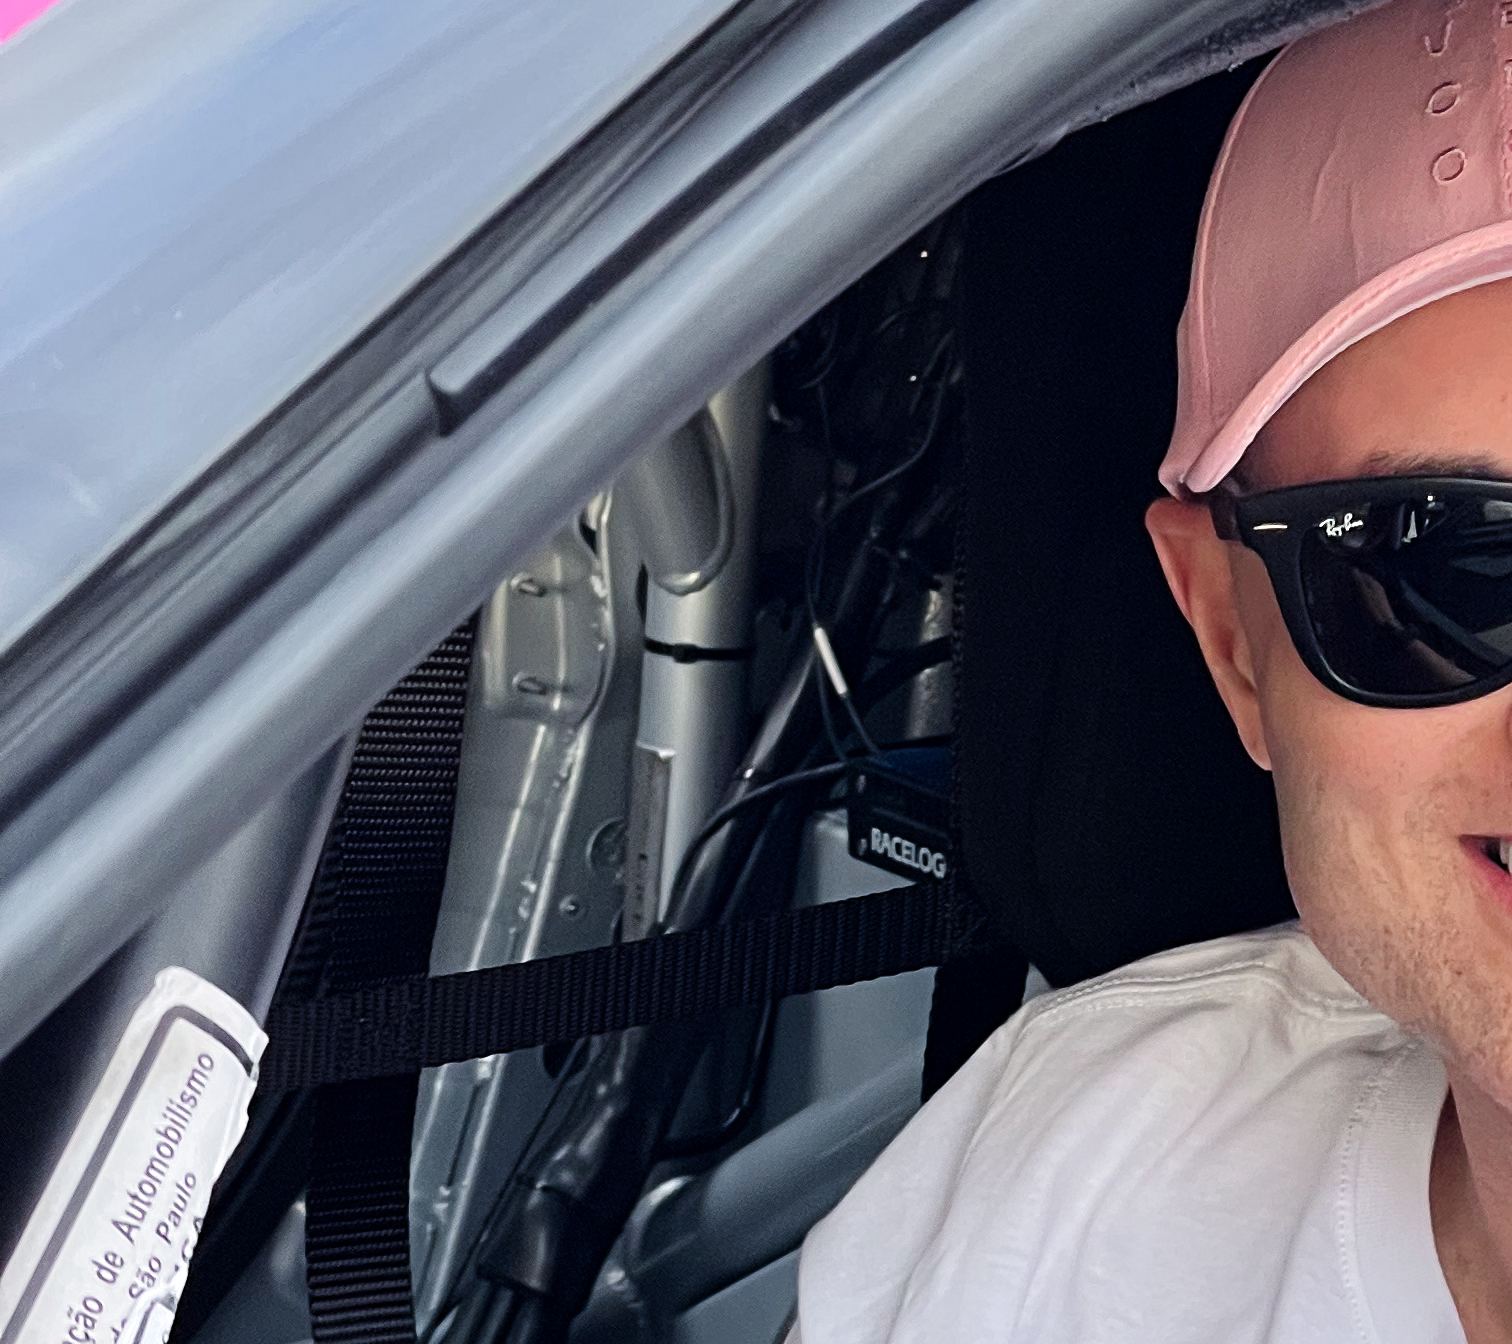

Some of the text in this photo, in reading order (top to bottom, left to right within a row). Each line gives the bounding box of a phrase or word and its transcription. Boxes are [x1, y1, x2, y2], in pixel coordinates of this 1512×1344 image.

[871, 827, 947, 878] RACELOG
[96, 1251, 125, 1285] de
[111, 1053, 215, 1246] Automobilismo
[156, 1172, 197, 1245] Paulo
